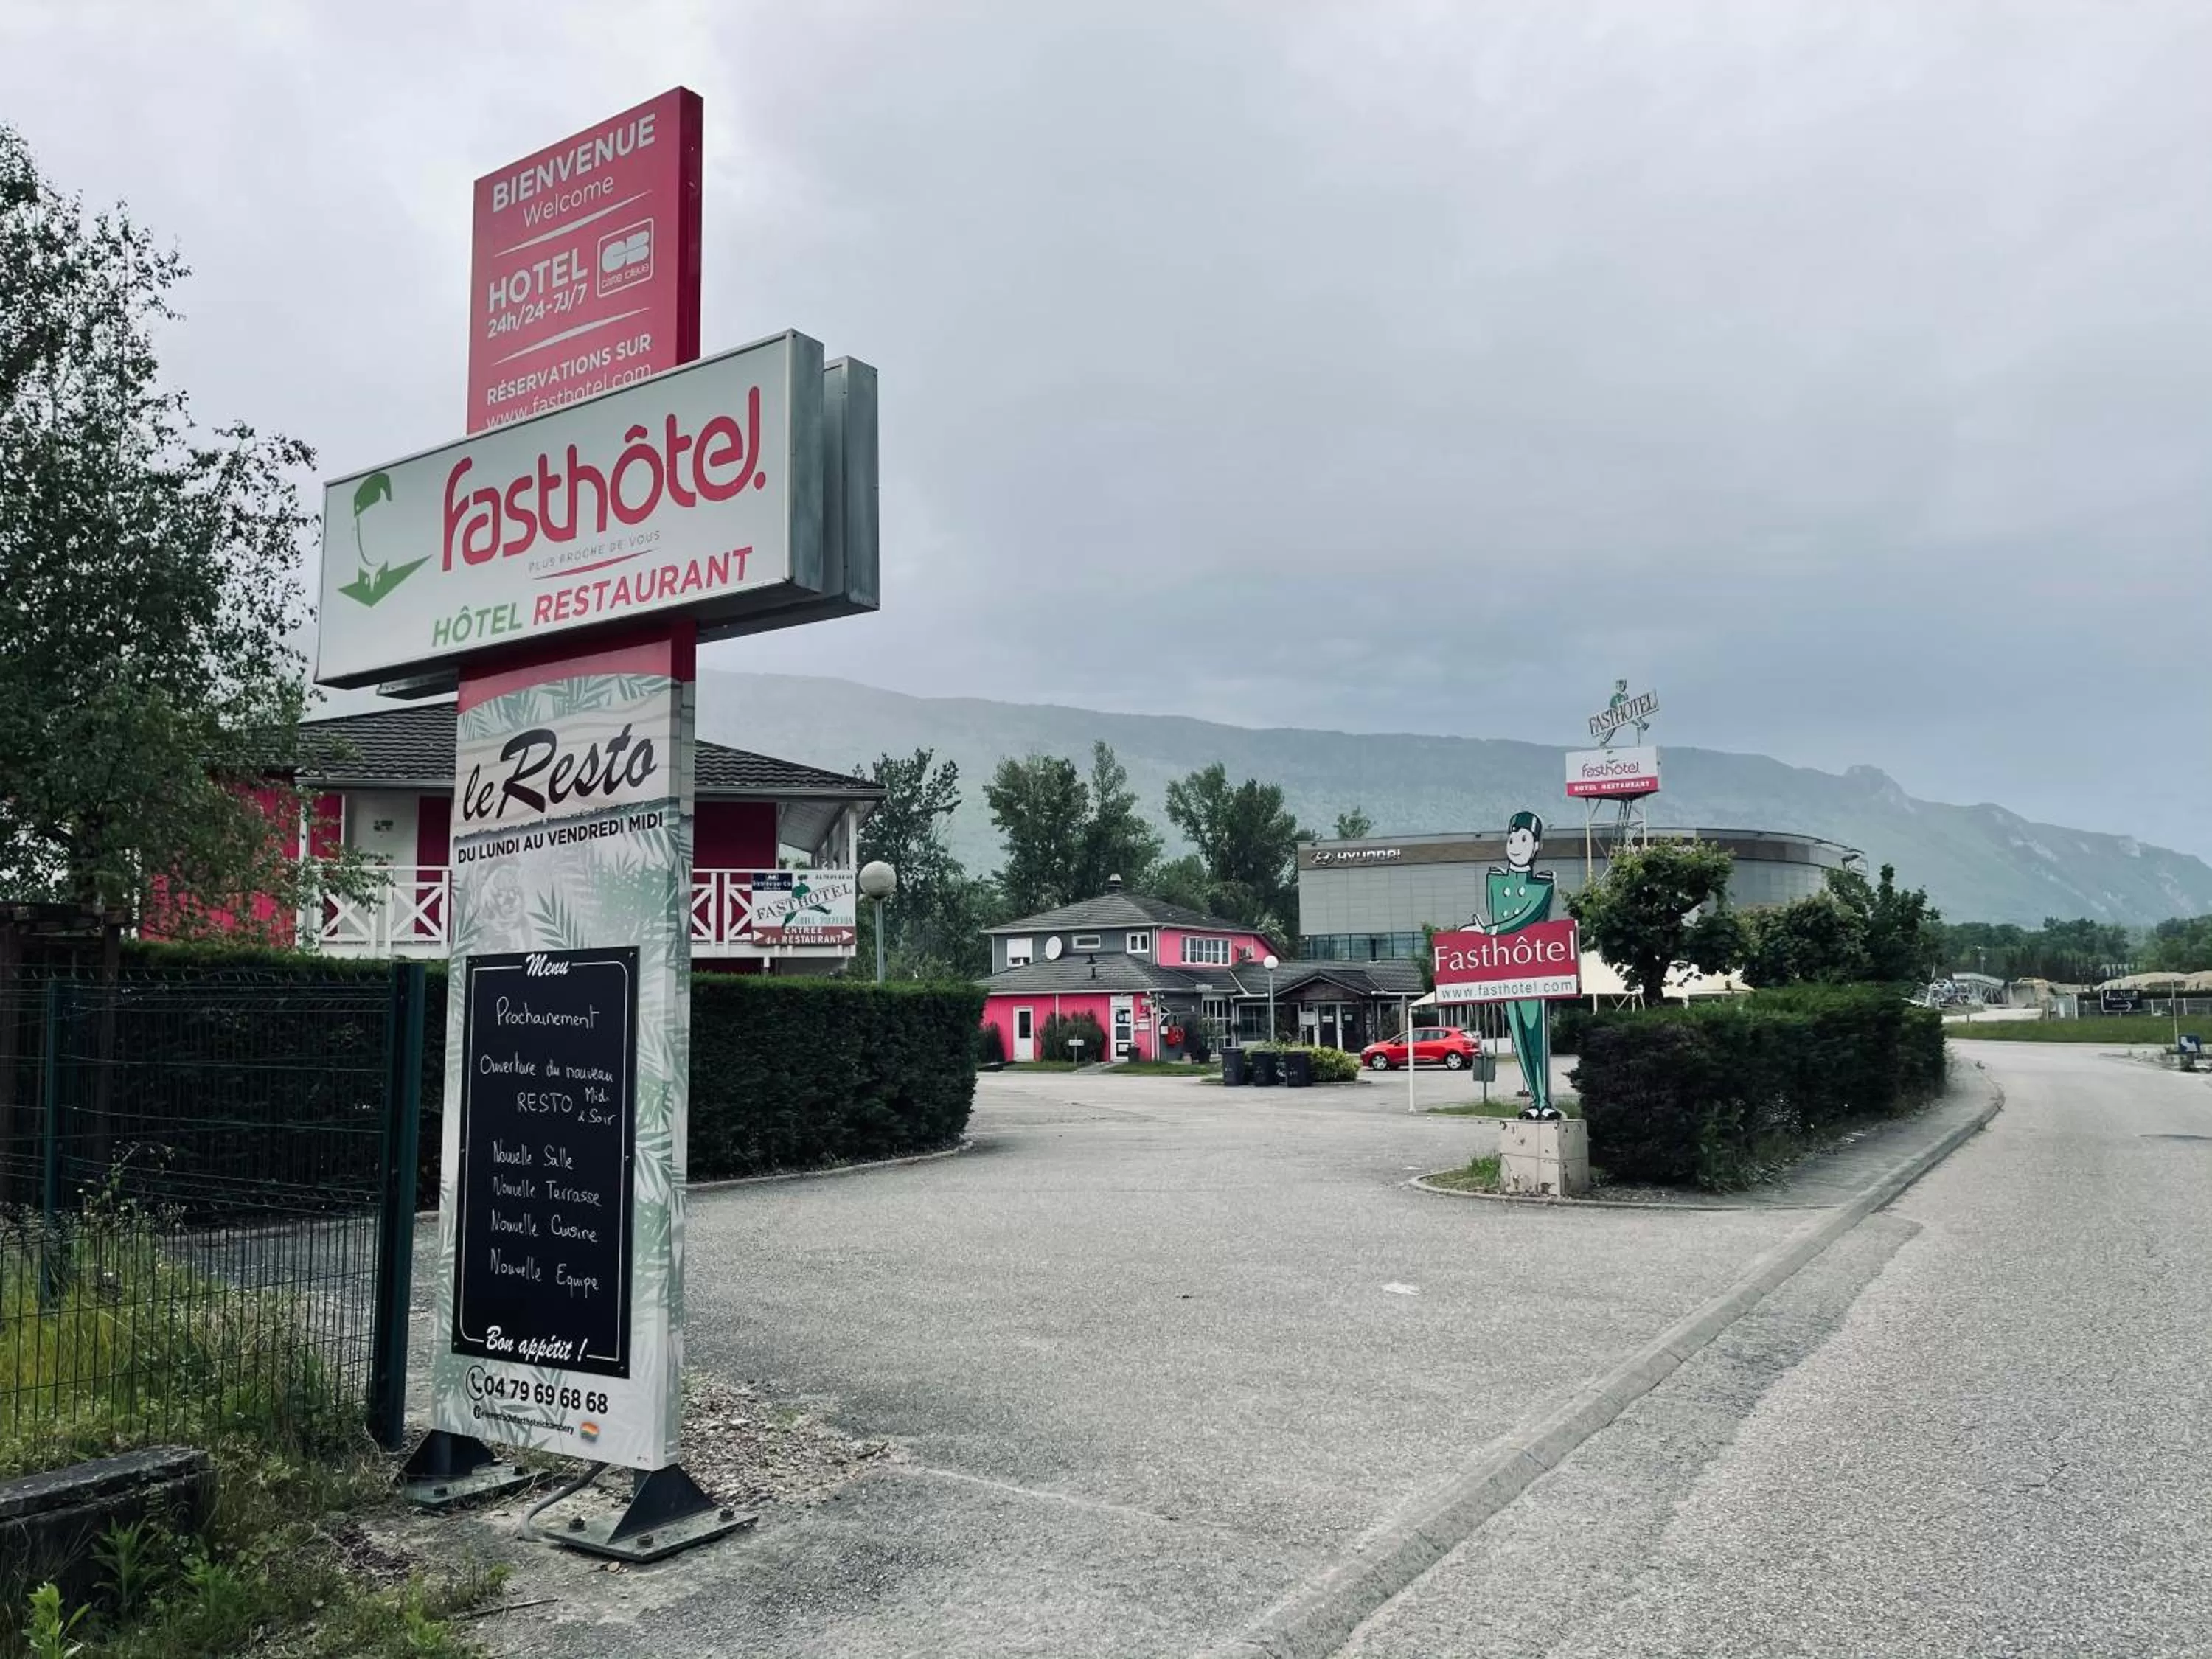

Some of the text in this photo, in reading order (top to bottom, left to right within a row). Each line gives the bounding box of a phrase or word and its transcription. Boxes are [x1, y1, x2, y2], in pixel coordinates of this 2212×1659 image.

[492, 113, 655, 213] BIENVENUE
[522, 176, 614, 227] Welcome
[488, 247, 588, 313] HOTEL
[487, 333, 652, 406] RÉSERVATIONS SUR
[485, 363, 652, 429] www.fasthotel.com
[528, 530, 661, 573] PLUS PROCHE DE VOUS
[431, 546, 754, 648] HÔTEL RESTAURANT
[1588, 687, 1659, 736] FASTHOTEL
[462, 722, 658, 821] le Resto
[1601, 780, 1650, 790] RESTAURANT
[457, 811, 664, 865] DU LUNDI AU VENDREDI MIDI
[1337, 849, 1401, 862] HYUNDAI
[756, 883, 854, 921] FASTHOTEL
[781, 934, 841, 945] RESTAURANT
[1433, 930, 1576, 973] Fasthôtel
[525, 953, 571, 977] Menu
[1441, 980, 1573, 1000] www.fasthotel.com
[496, 996, 600, 1029] Prochainement
[480, 1050, 614, 1083] Ouverture du nouveau
[516, 1091, 574, 1113] RESTO
[588, 1108, 617, 1125] Soir
[493, 1138, 574, 1171] Nouvelle Salle
[492, 1174, 602, 1208] Nouvelle Terrasse
[490, 1208, 540, 1237] Nouvelle
[490, 1248, 599, 1298] Nouvelle Equipe
[486, 1325, 515, 1352] Bon
[518, 1335, 573, 1363] appétit
[484, 1375, 608, 1414] 04 79 69 68 68
